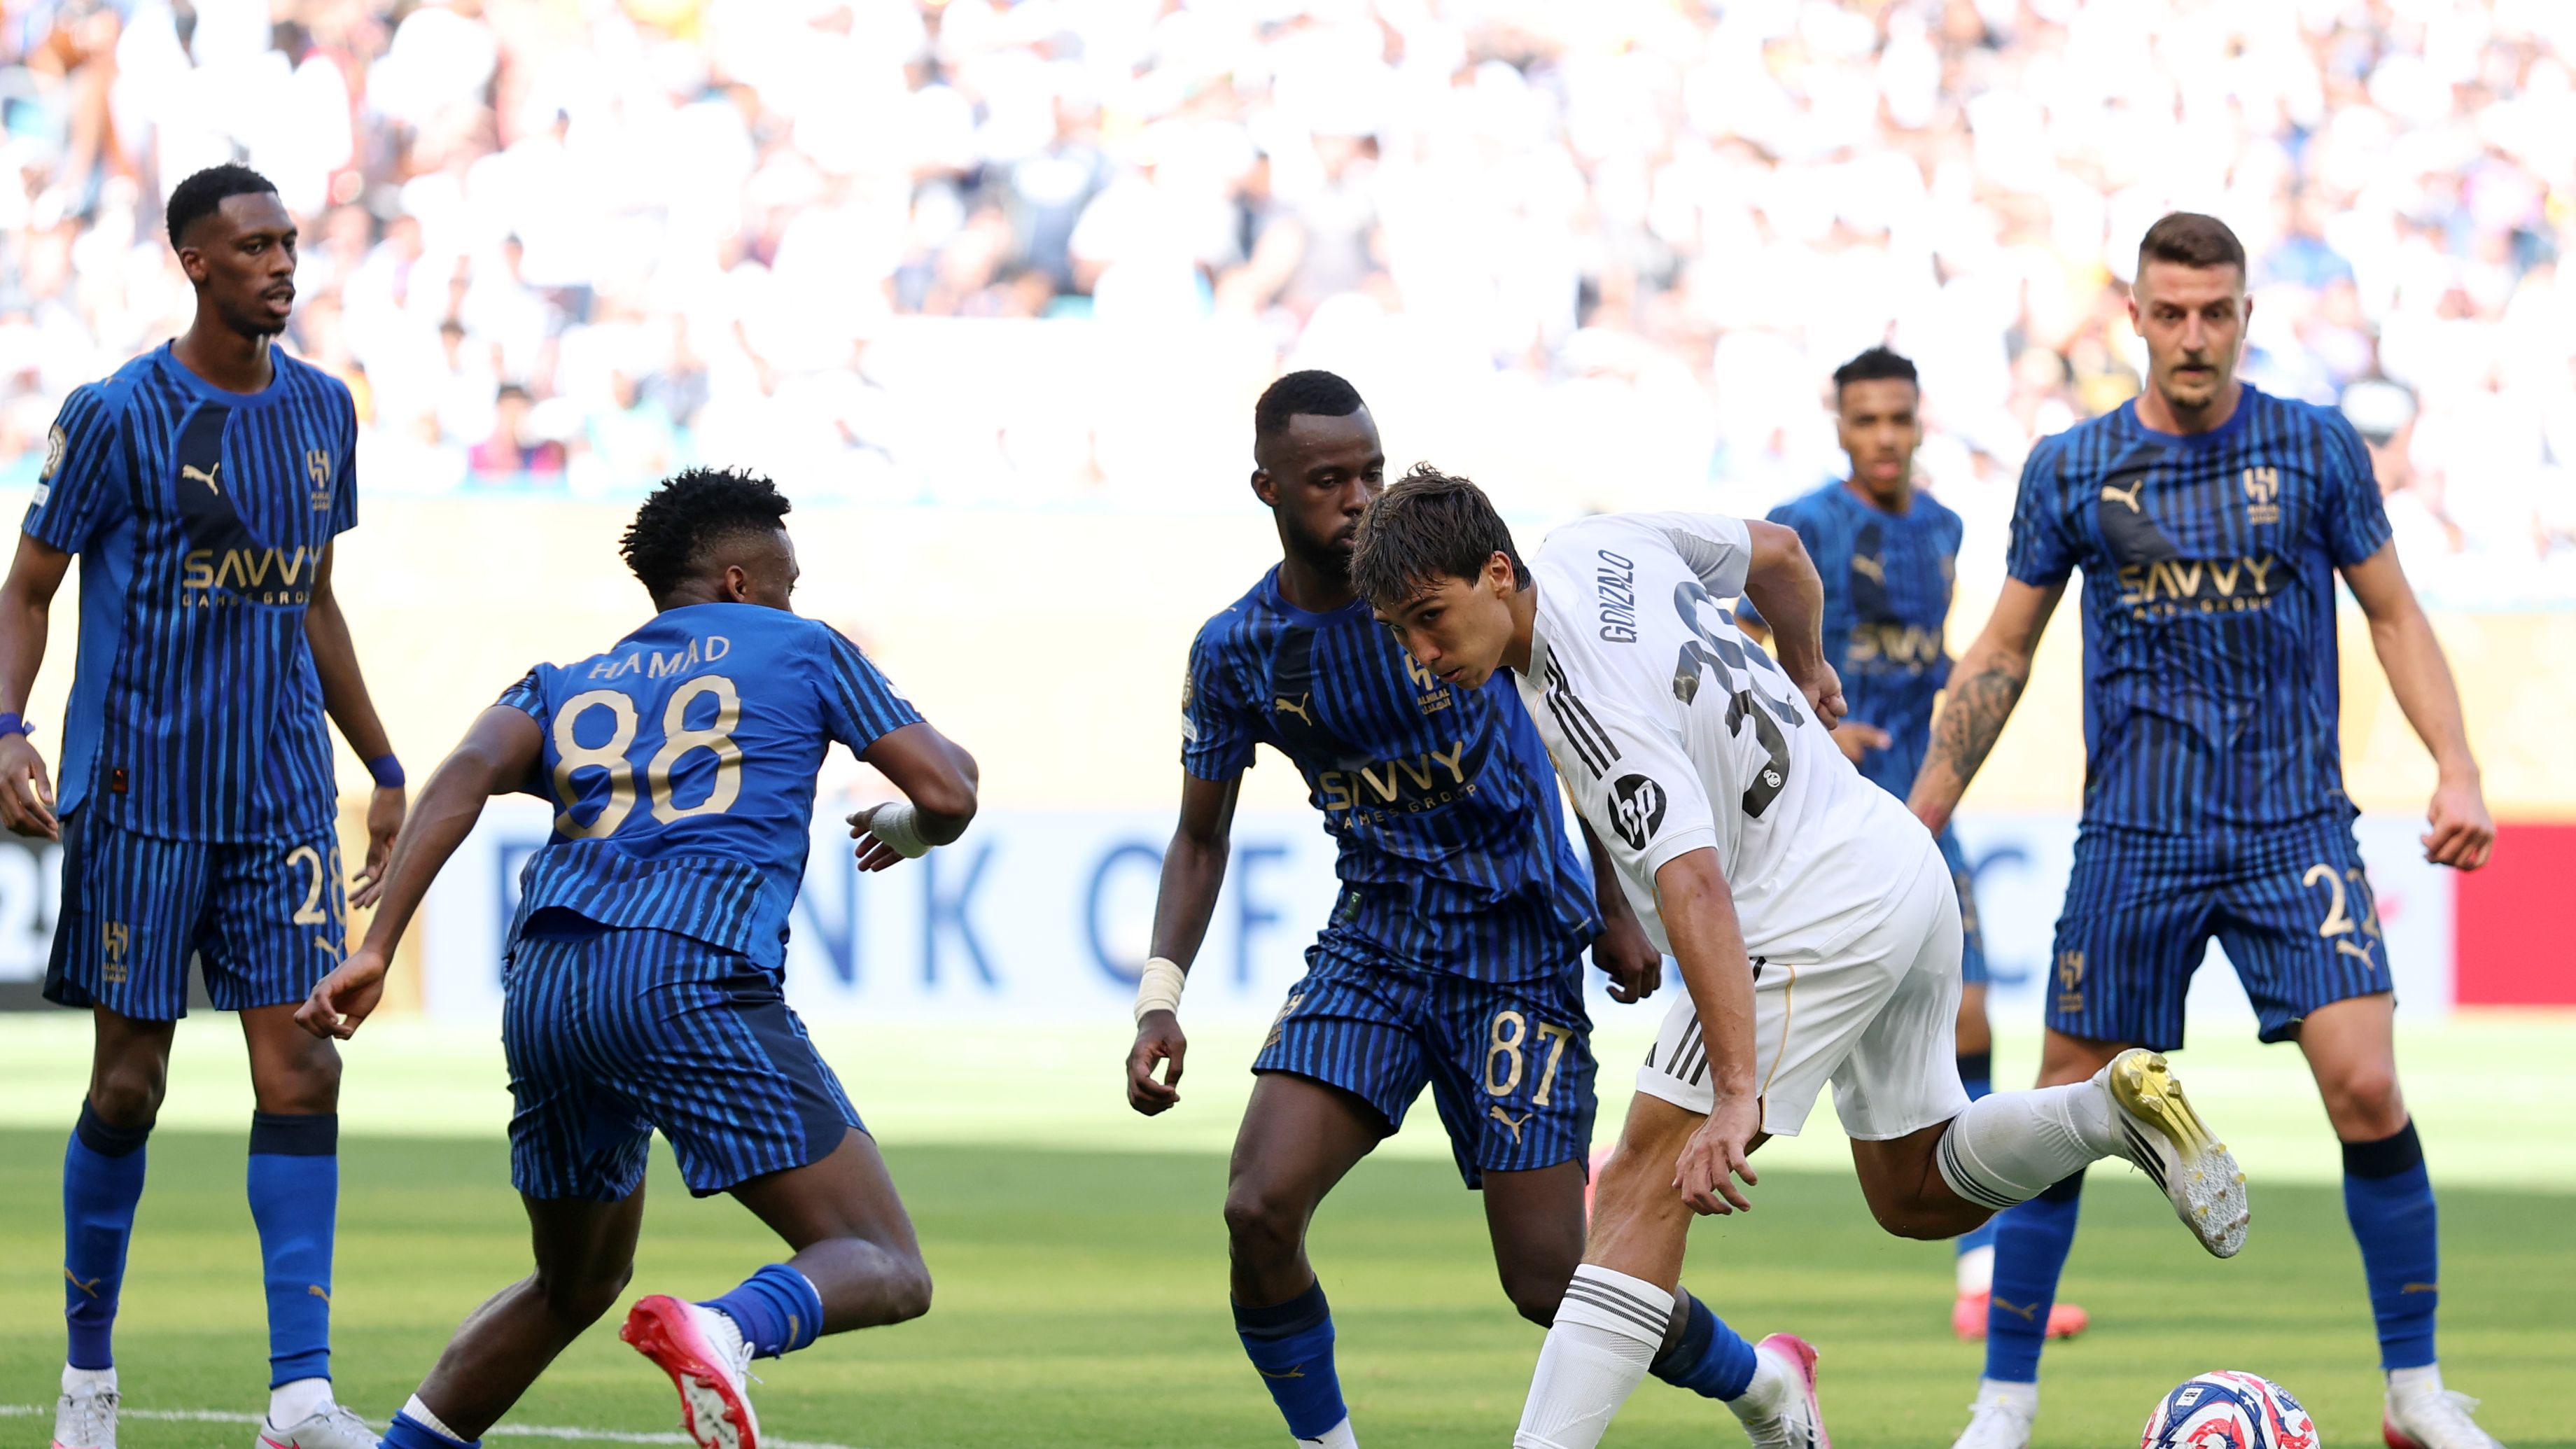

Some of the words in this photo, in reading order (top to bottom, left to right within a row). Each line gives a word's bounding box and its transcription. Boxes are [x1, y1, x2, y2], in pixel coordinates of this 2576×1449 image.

[183, 545, 322, 588] SAVVY
[2117, 555, 2274, 604] SAVVY
[263, 591, 310, 606] GRO
[1597, 550, 1637, 643] GONZALO
[587, 636, 731, 679] HAMAD
[552, 674, 742, 840] 88
[1319, 741, 1464, 811] SAVVY
[1343, 809, 1400, 830] AMES
[1608, 776, 1658, 849] hp
[1485, 1010, 1573, 1106] 87
